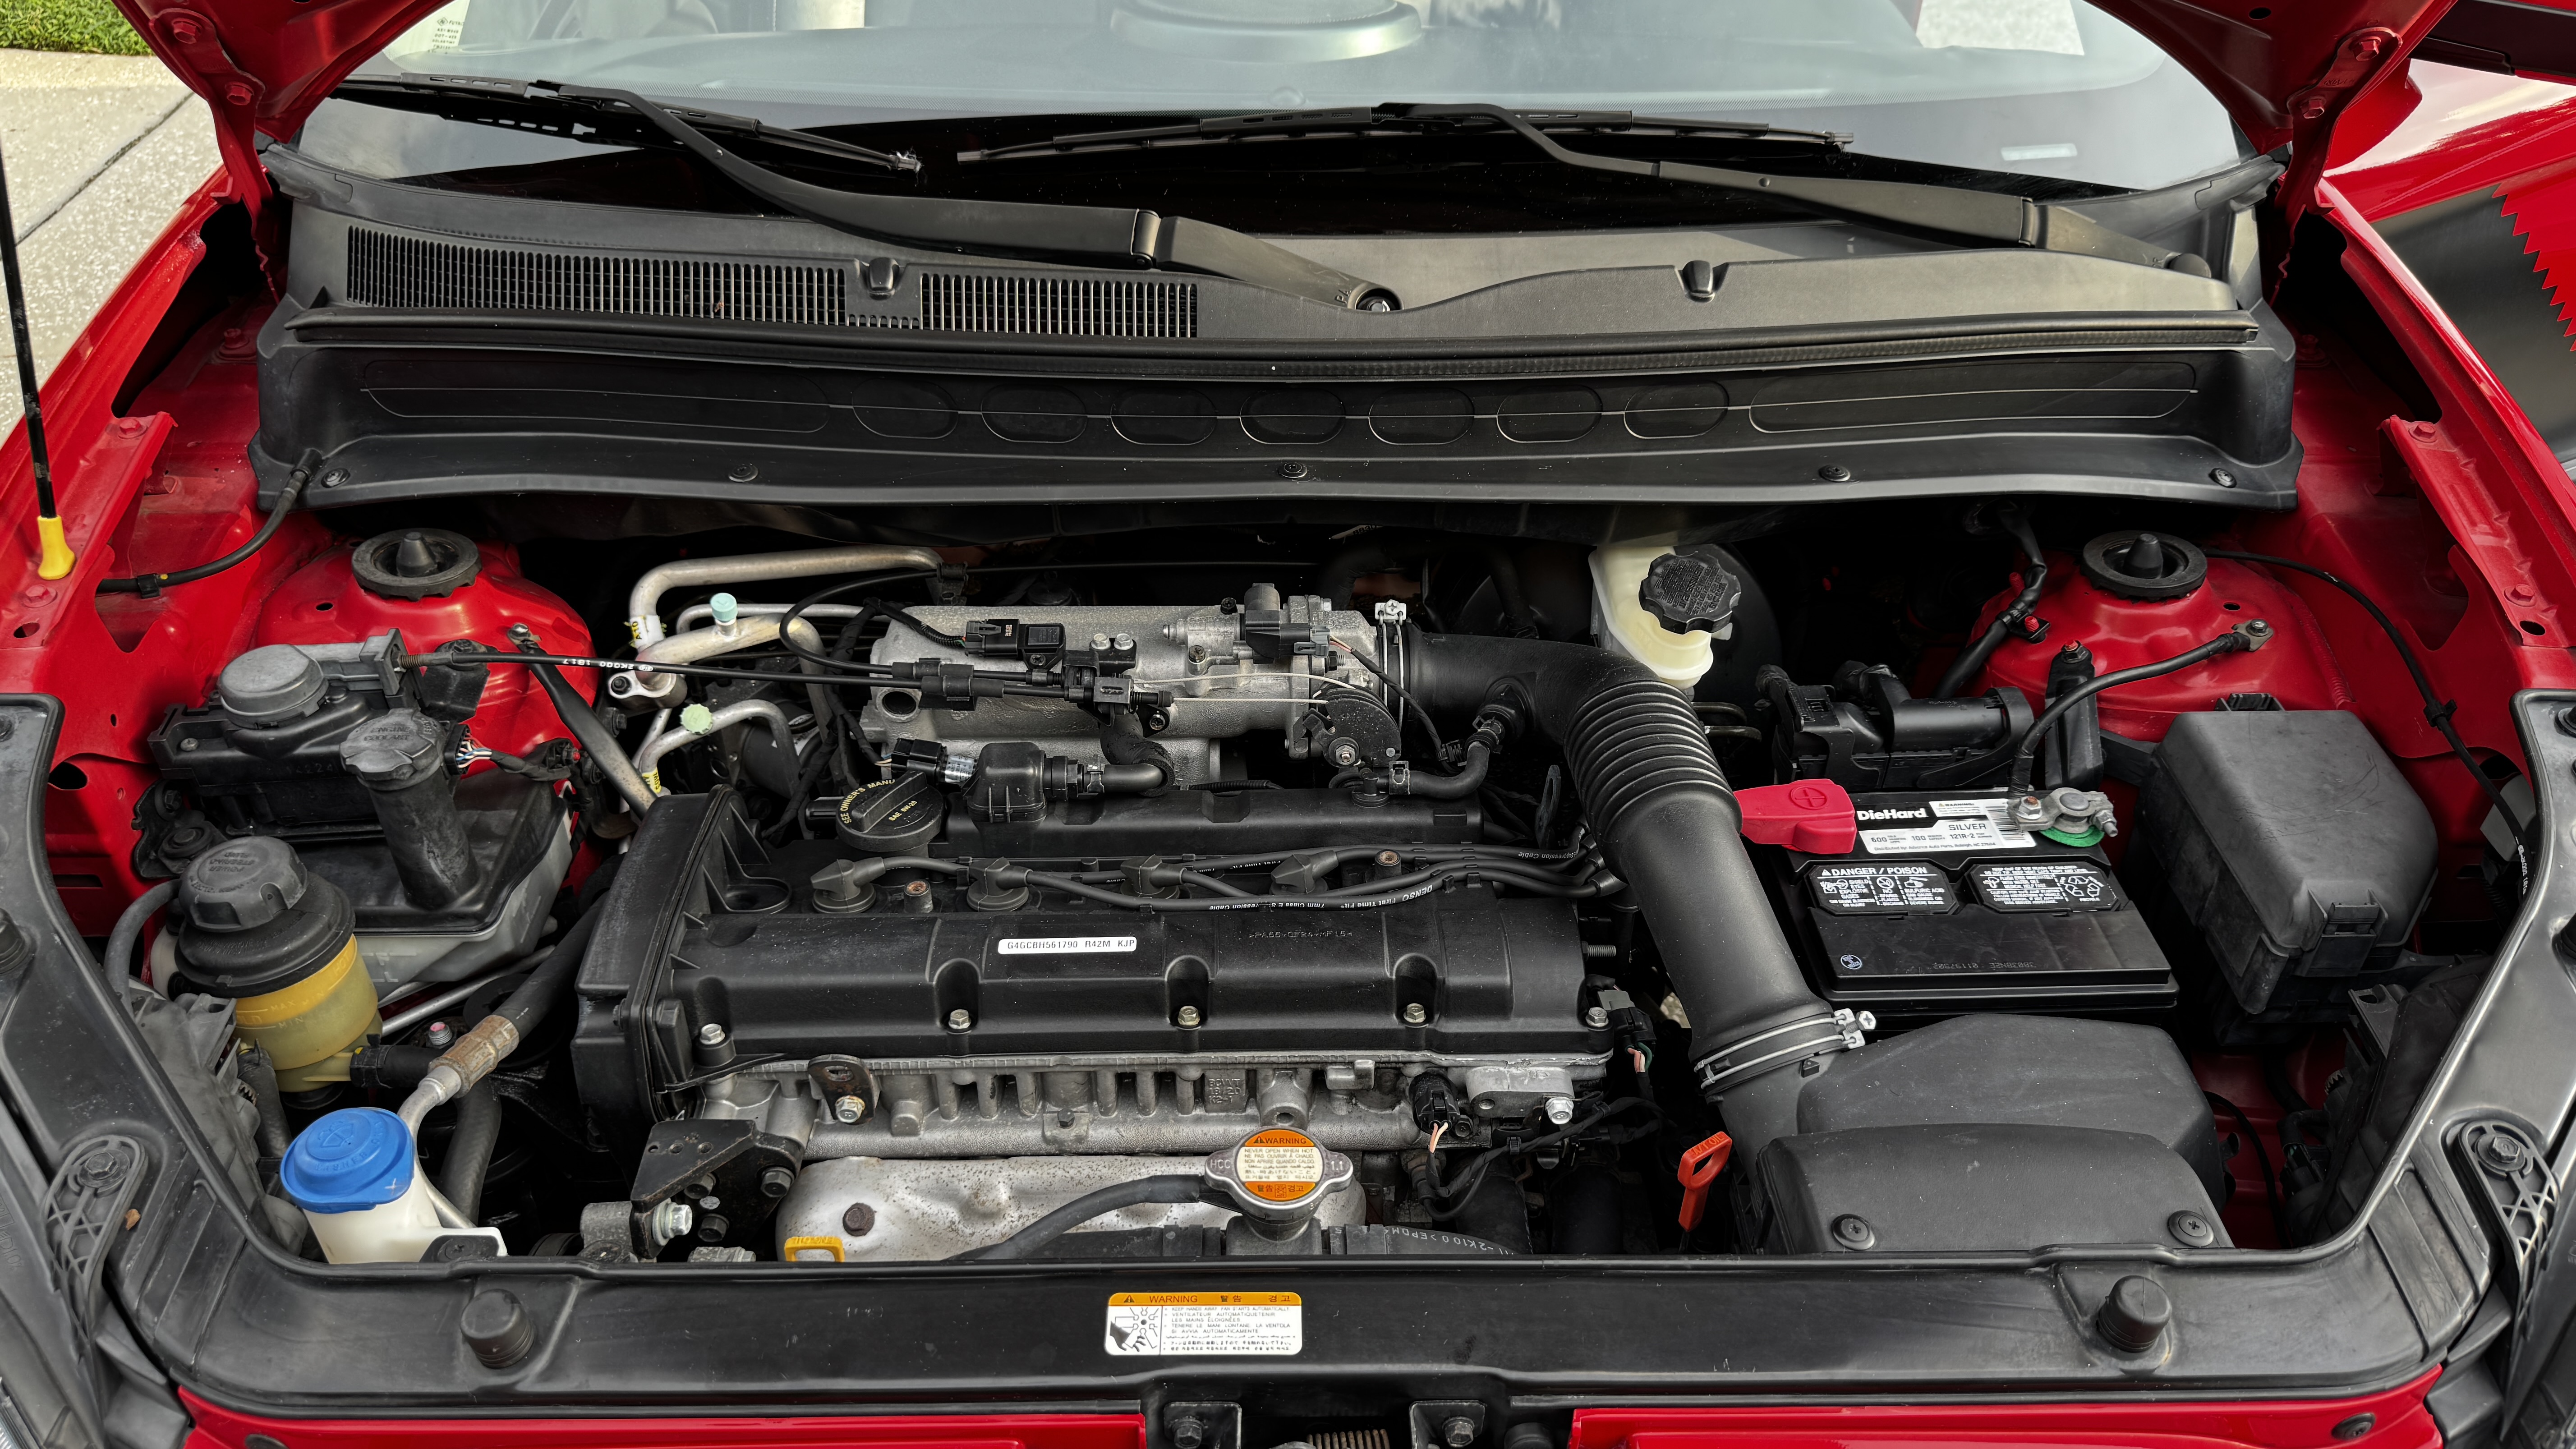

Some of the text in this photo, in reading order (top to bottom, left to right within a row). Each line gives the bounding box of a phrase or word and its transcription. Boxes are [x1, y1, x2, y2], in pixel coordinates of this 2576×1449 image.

[840, 779, 895, 824] SEE OWNER'S MANU
[888, 812, 902, 821] SAE
[1857, 808, 1927, 820] DieHard
[1831, 868, 1877, 876] DANGER
[1402, 884, 1433, 902] DENSO
[1379, 897, 1396, 906] First
[271, 1000, 296, 1012] MAX
[279, 1017, 304, 1029] MIN
[1708, 1134, 1725, 1145] OIL
[1210, 1159, 1231, 1169] HCC
